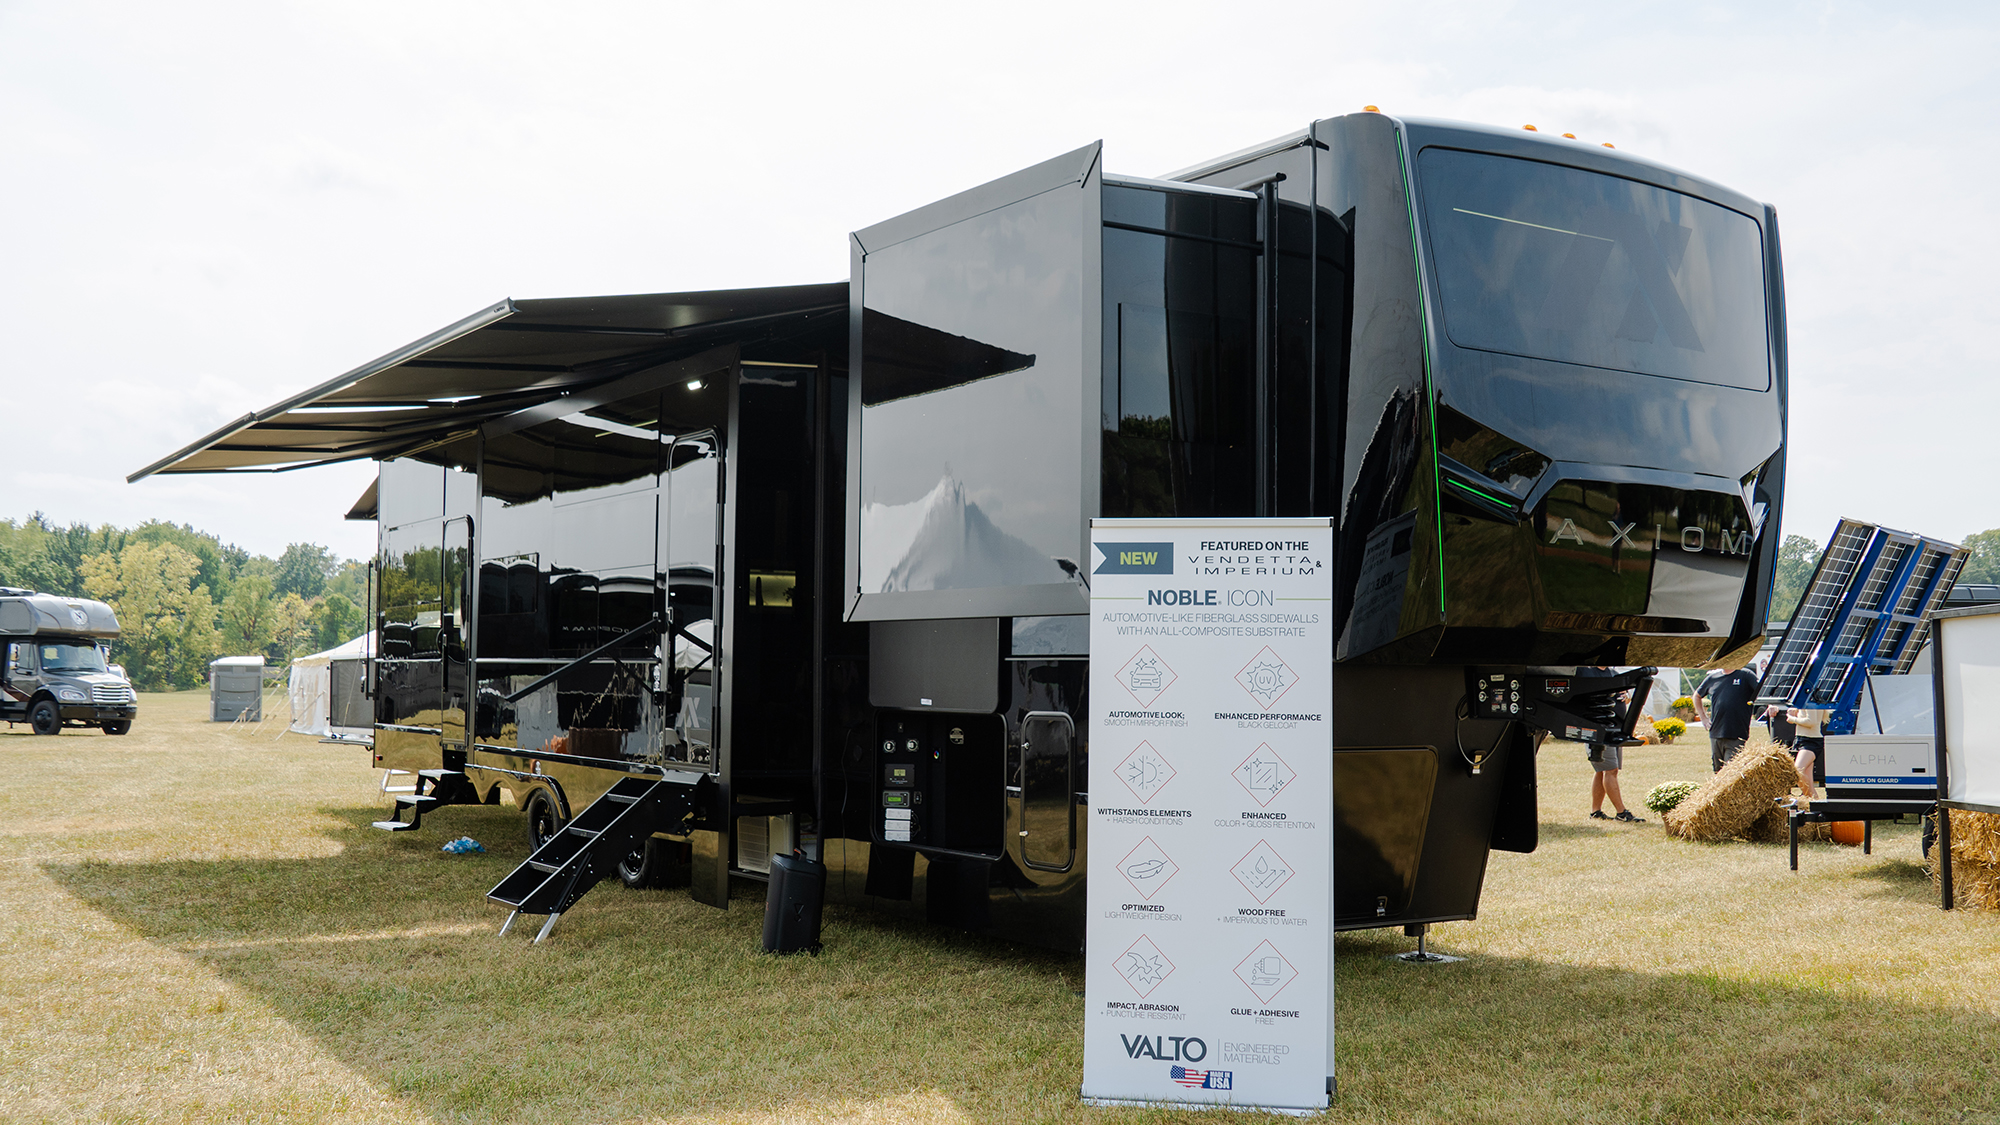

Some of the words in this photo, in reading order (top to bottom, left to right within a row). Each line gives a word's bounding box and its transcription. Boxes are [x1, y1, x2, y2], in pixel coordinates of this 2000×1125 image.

[1549, 518, 1748, 556] AXIOM
[1201, 541, 1263, 551] FEATURED
[1265, 541, 1283, 551] ON
[1285, 541, 1309, 551] THE
[1120, 552, 1158, 565] NEW
[1188, 556, 1312, 564] VENDETTA
[1195, 567, 1314, 575] IMPERIUM
[1227, 590, 1274, 607] ICON
[1103, 613, 1193, 623] AUTOMOTIVE-LIKE
[1195, 613, 1259, 623] FIBERGLASS
[1260, 614, 1319, 624] SIDEWALLS
[1117, 626, 1142, 635] WITH
[1145, 627, 1158, 635] AN
[1159, 627, 1243, 636] ALL-COMPOSITE
[1245, 627, 1305, 637] SUBSTRATE
[1259, 676, 1272, 685] UV
[1109, 711, 1160, 719] AUTOMOTIVE
[1214, 713, 1259, 721] ENHANCED
[1260, 713, 1321, 722] PERFORMANCE
[1104, 719, 1135, 727] SMOOTH
[1135, 719, 1165, 727] MIRROR
[1165, 720, 1188, 728] FINISH
[1238, 721, 1263, 729] BLACK
[1263, 721, 1298, 729] GELCOAT
[1849, 754, 1897, 765] ALPHA
[1098, 808, 1149, 817] WITHSTANDS
[1149, 809, 1192, 818] ELEMENTS
[1241, 812, 1286, 820] ENHANCED
[1113, 817, 1138, 825] HARSH
[1138, 817, 1183, 826] CONDITIONS
[1214, 819, 1240, 828] COLOR
[1246, 820, 1272, 828] GLOSS
[1273, 820, 1315, 829] RETENTION
[1121, 904, 1165, 912] OPTIMIZED
[1238, 908, 1264, 917] WOOD
[1265, 909, 1286, 917] FREE
[1105, 911, 1153, 920] LIGHTWEIGHT
[1154, 912, 1182, 921] DESIGN
[1223, 916, 1268, 925] IMPERVIOUS
[1268, 917, 1279, 925] TO
[1281, 918, 1307, 926] WATER
[1107, 1002, 1137, 1011] IMPACT,
[1138, 1003, 1179, 1012] ABRASION
[1106, 1010, 1145, 1019] PUNCTURE
[1148, 1012, 1186, 1021] RESISTANT
[1231, 1008, 1252, 1016] GLUE
[1259, 1009, 1300, 1018] ADHESIVE
[1255, 1017, 1274, 1026] FREE
[1120, 1033, 1207, 1063] VALTO
[1224, 1042, 1290, 1055] ENGINEERED
[1224, 1053, 1280, 1065] MATERIALS
[1209, 1077, 1230, 1090] USA
